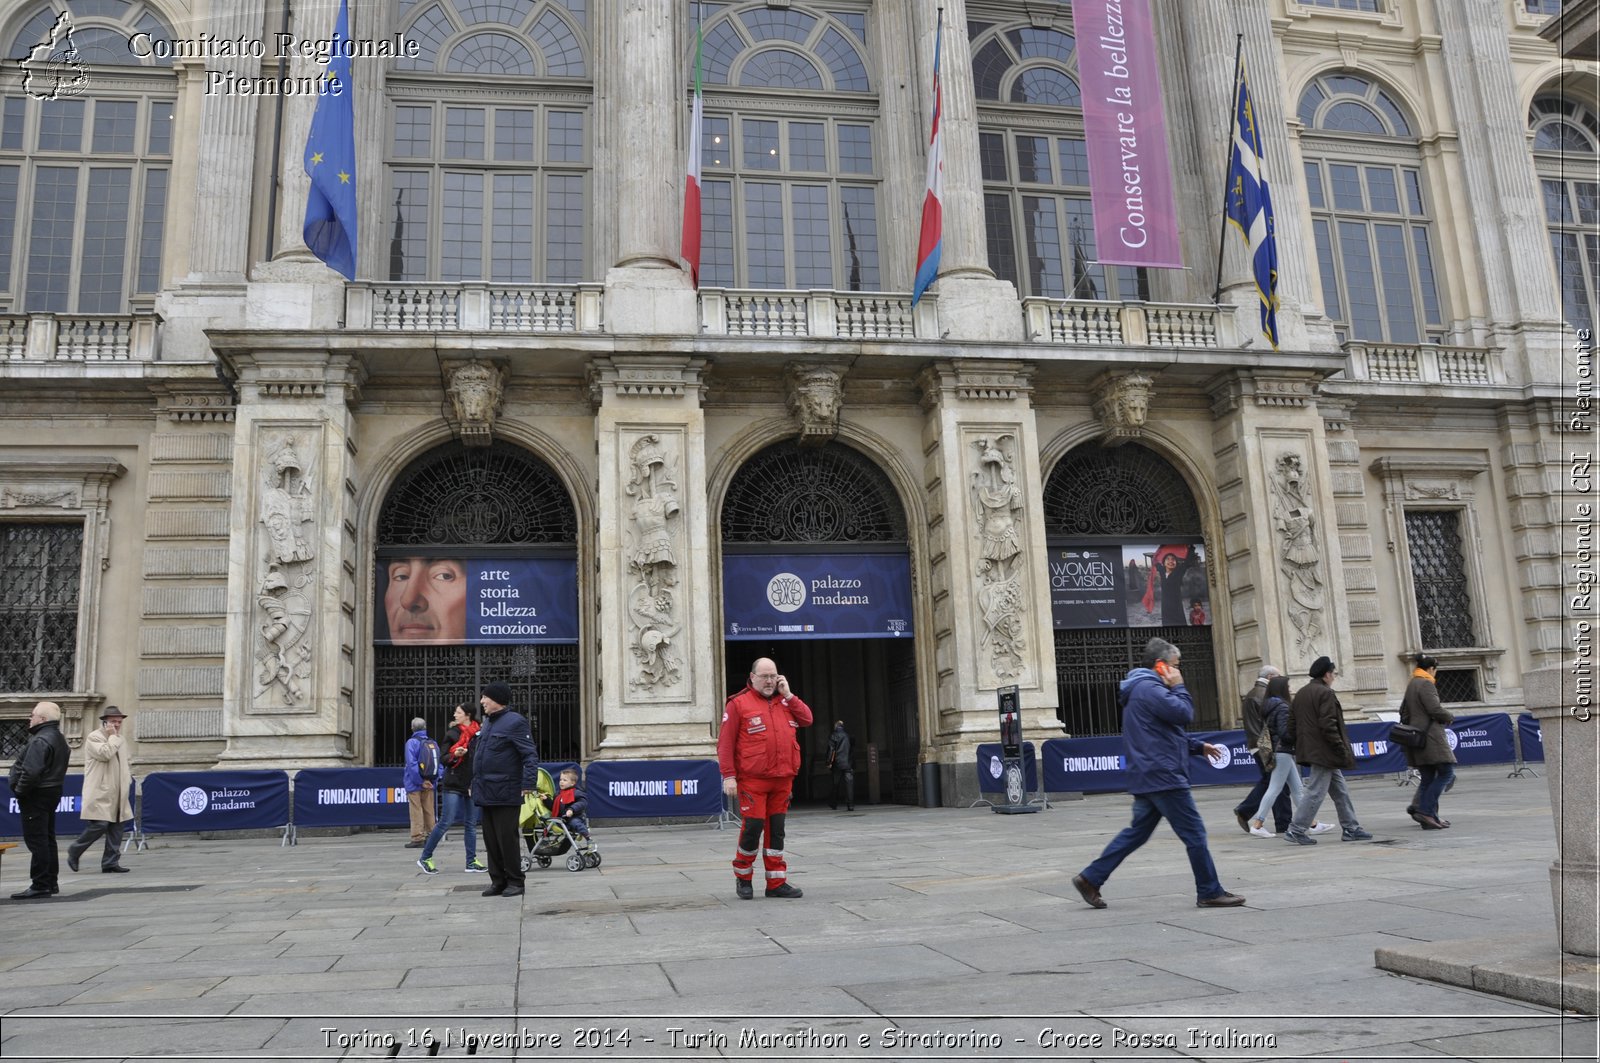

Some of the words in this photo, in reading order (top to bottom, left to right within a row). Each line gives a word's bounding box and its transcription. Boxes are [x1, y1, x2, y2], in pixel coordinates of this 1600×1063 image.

[1100, 0, 1129, 80] bellezz
[1106, 87, 1133, 106] la
[1118, 112, 1148, 249] Conservare
[480, 570, 510, 581] arte
[1050, 562, 1113, 576] WOMEN
[812, 575, 862, 592] palazzo
[1052, 575, 1070, 587] OF
[1072, 575, 1114, 587] VISION
[480, 585, 520, 599] storia
[812, 592, 869, 605] madama
[480, 602, 537, 617] bellezza
[480, 621, 547, 635] emozione
[1458, 728, 1488, 740] palazzo
[1373, 740, 1388, 755] CRT
[1460, 738, 1493, 748] madama
[1064, 755, 1120, 772] FONDAZIONE
[1233, 755, 1256, 765] mada
[211, 787, 250, 801] palazzo
[608, 780, 668, 797] FONDAZIONE
[681, 779, 699, 795] CRT
[318, 788, 380, 804] FONDAZIONE
[394, 787, 409, 803] CR
[211, 798, 256, 811] madama
